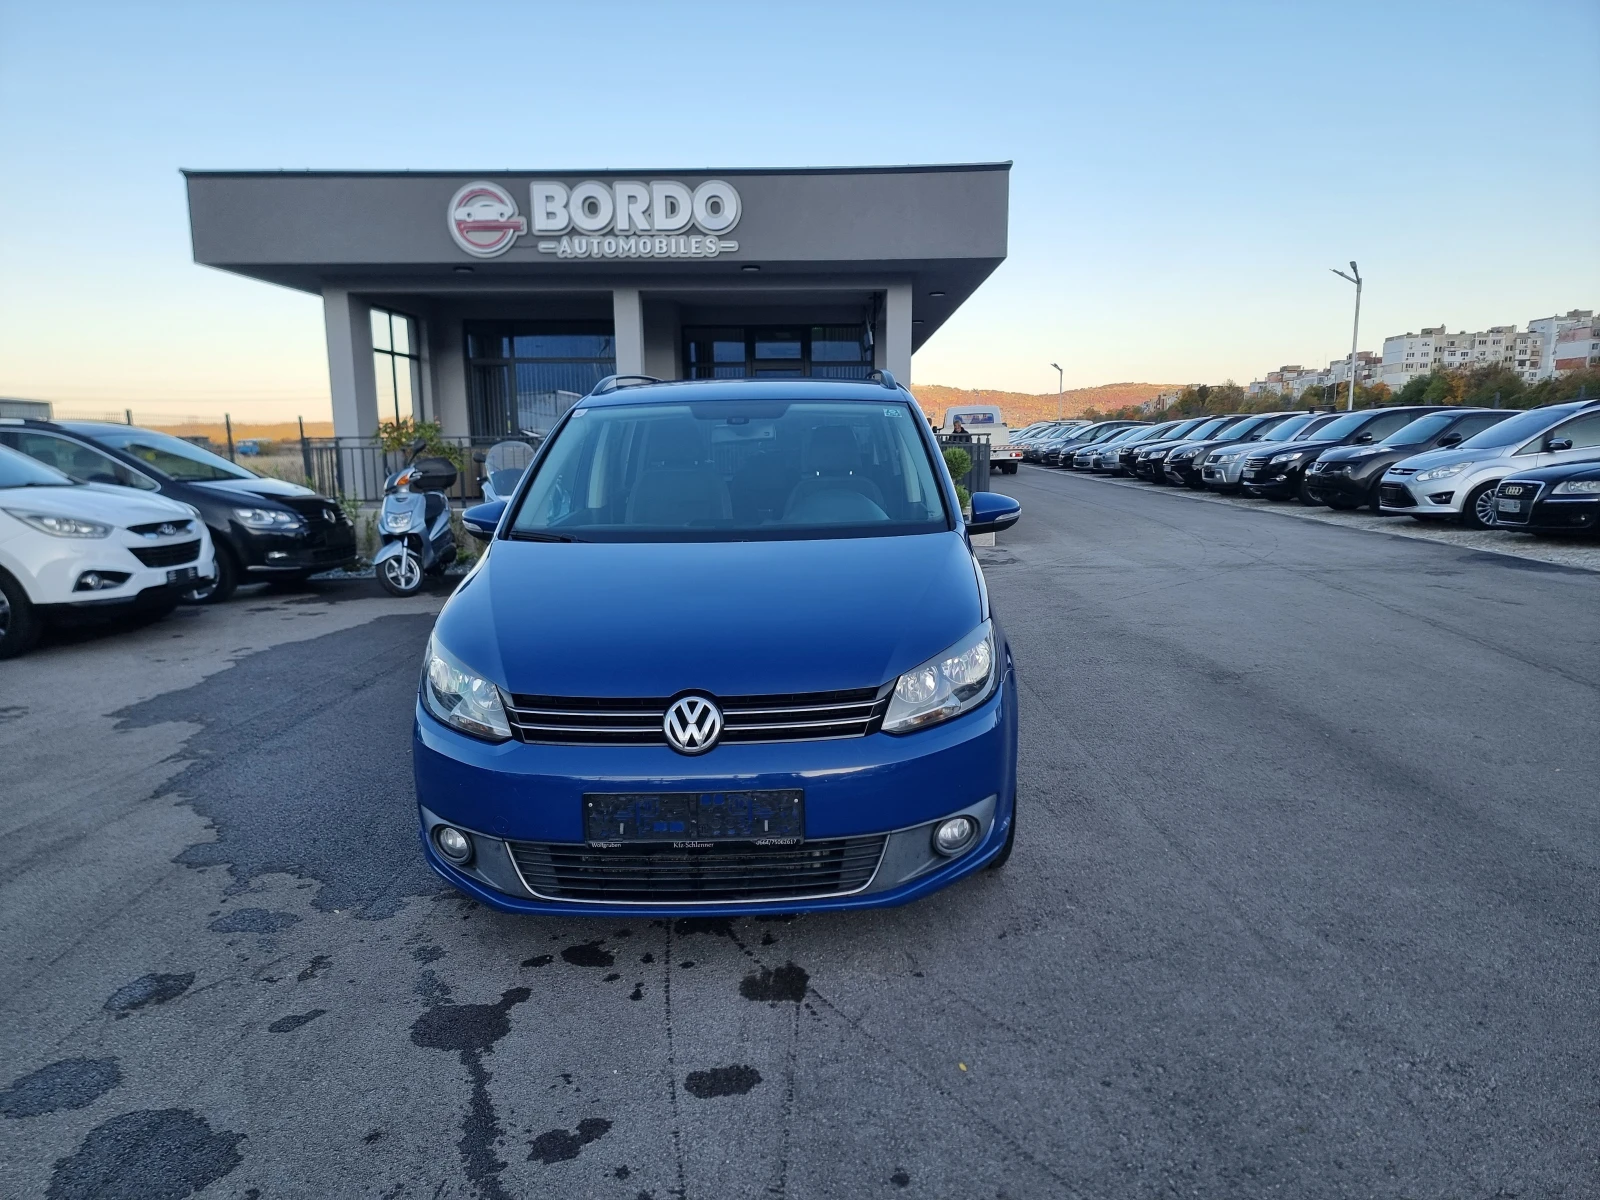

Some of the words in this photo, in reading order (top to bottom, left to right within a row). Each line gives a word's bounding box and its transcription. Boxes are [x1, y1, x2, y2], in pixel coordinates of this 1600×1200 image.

[531, 181, 740, 233] BORDO
[558, 236, 718, 256] AUTOMOBILES
[664, 696, 721, 752] VW
